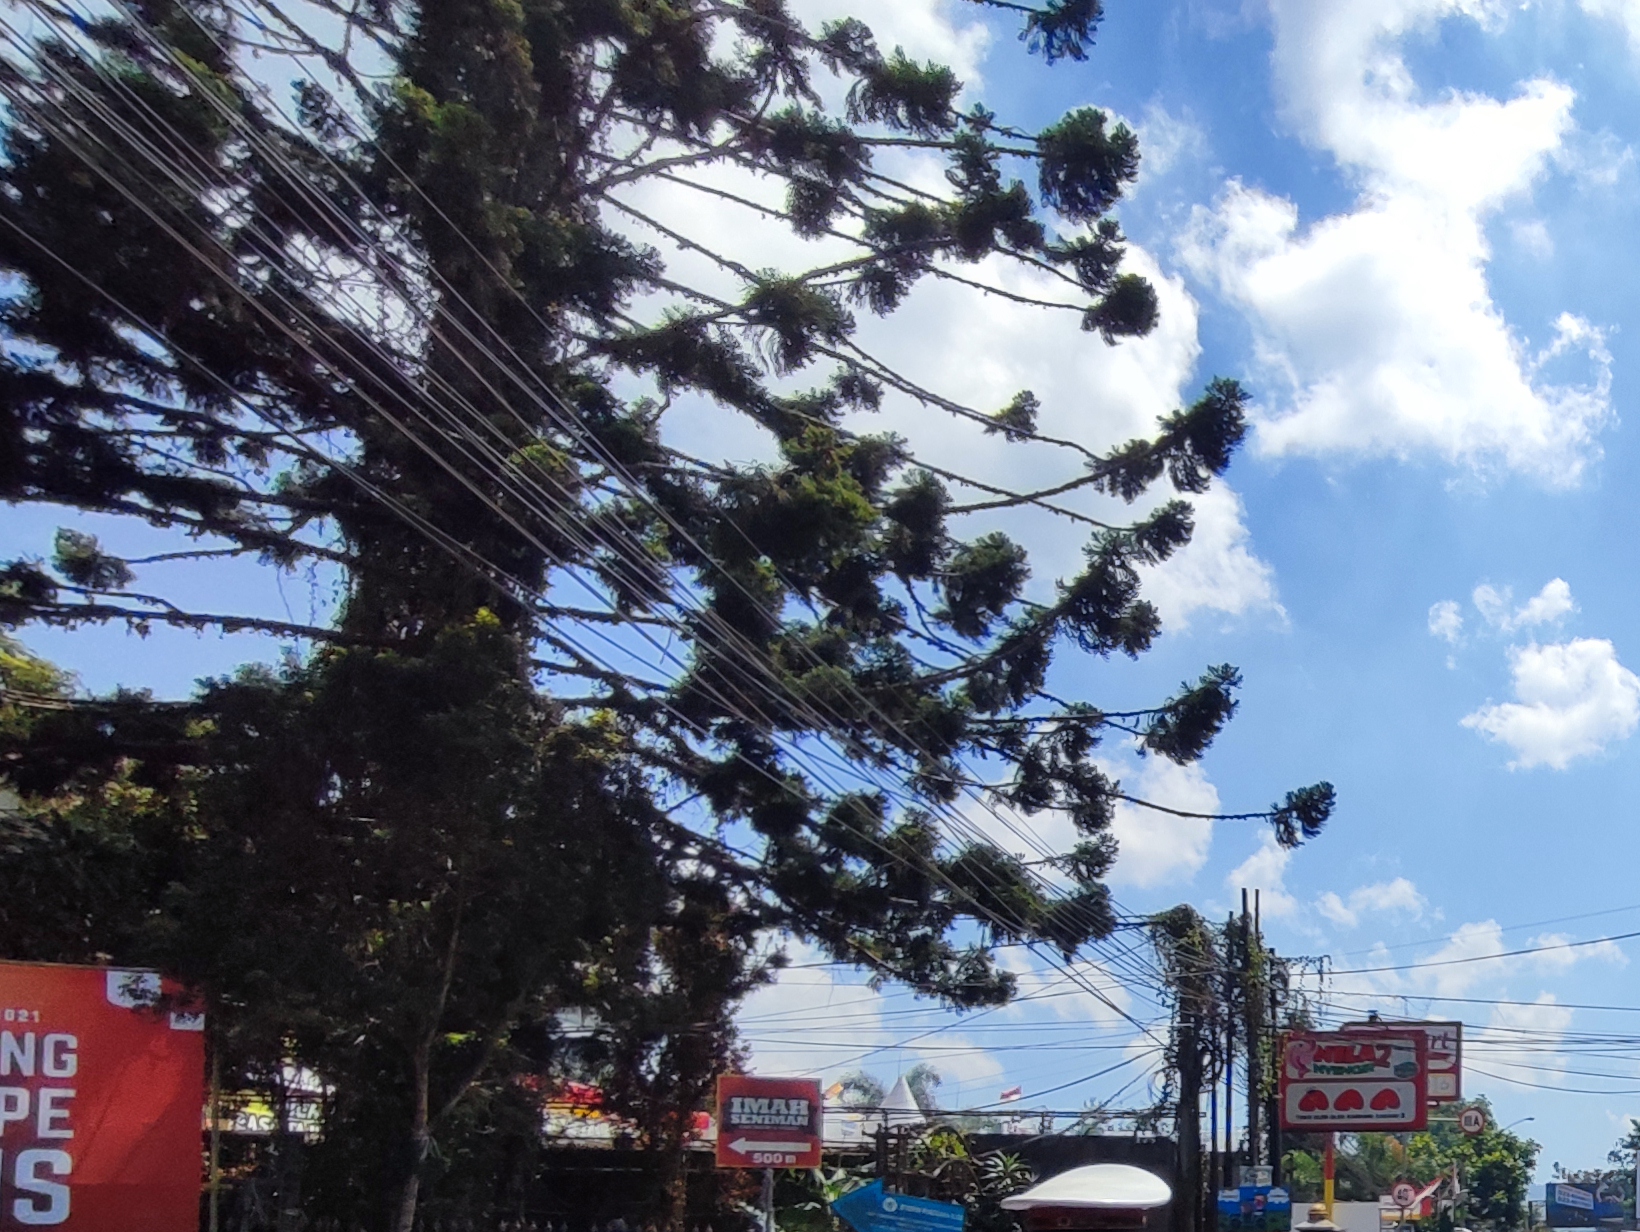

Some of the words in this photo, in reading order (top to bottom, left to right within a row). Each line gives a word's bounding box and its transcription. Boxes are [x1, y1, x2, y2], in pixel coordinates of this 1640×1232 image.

[731, 1097, 809, 1115] IMAH
[730, 1114, 809, 1126] SENIMAN
[752, 1152, 783, 1164] 500
[785, 1154, 796, 1164] m
[0, 1149, 73, 1225] S
